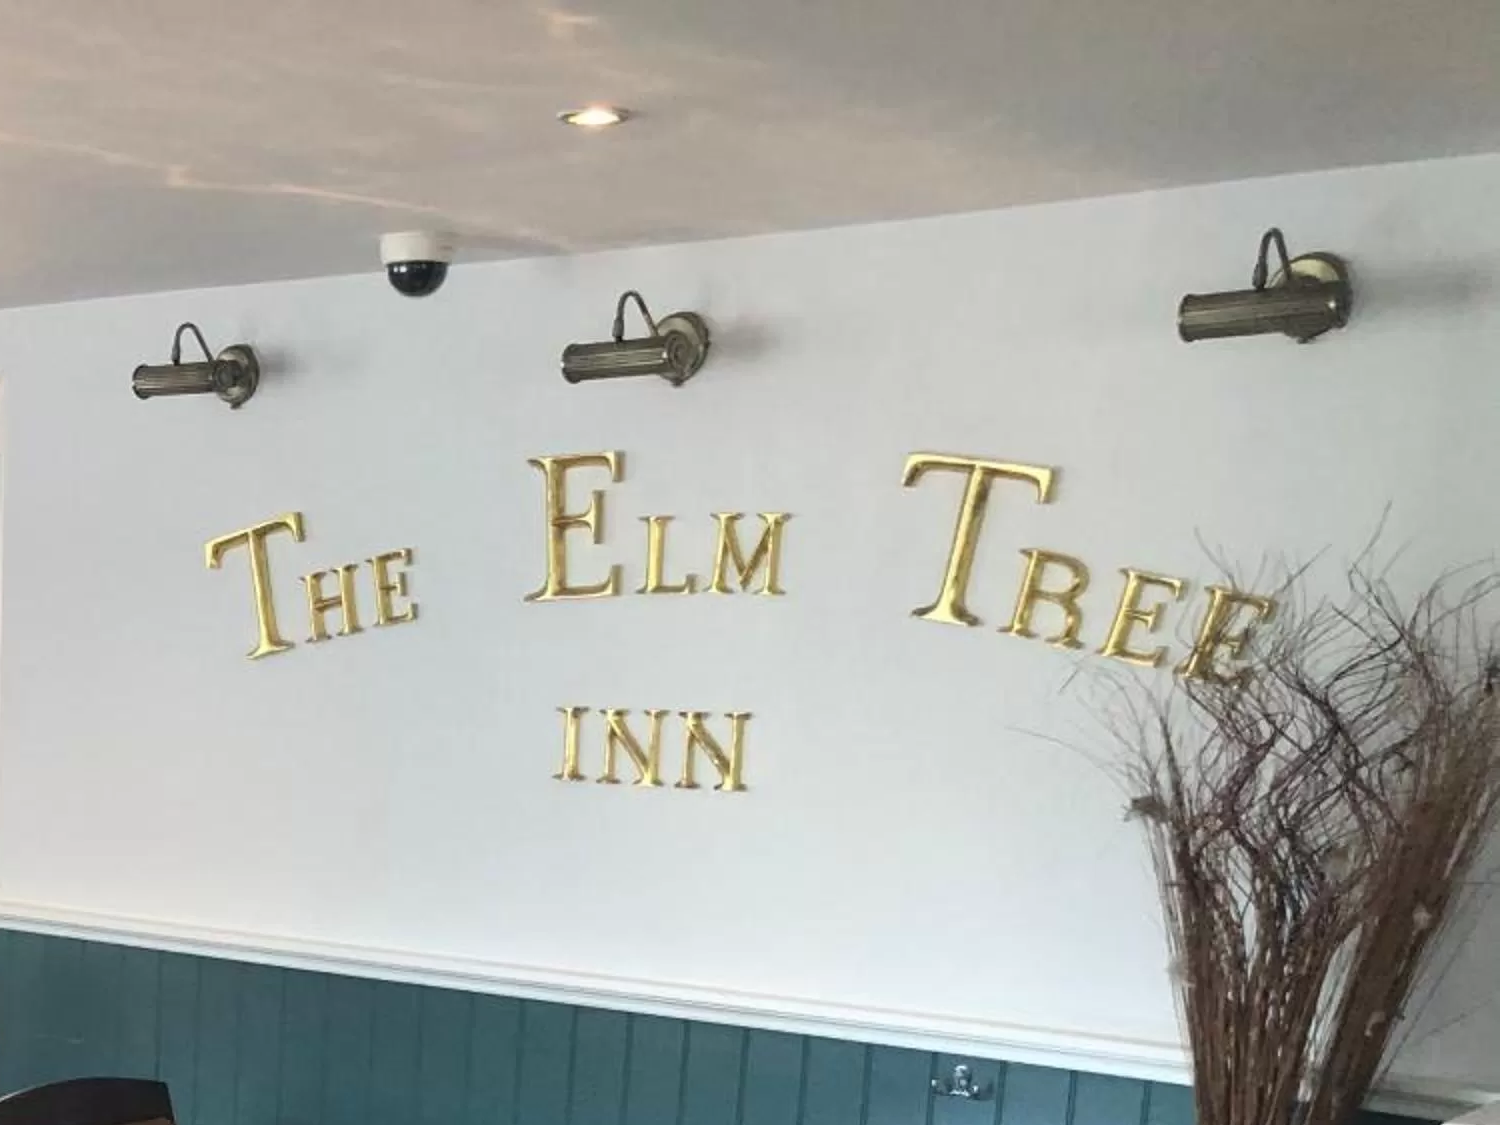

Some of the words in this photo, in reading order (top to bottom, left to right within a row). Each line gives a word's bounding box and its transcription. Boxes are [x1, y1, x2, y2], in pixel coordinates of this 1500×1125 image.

[204, 511, 418, 661] THE
[524, 450, 793, 603] ELM
[902, 453, 1277, 688] TREE
[552, 706, 751, 791] INN
